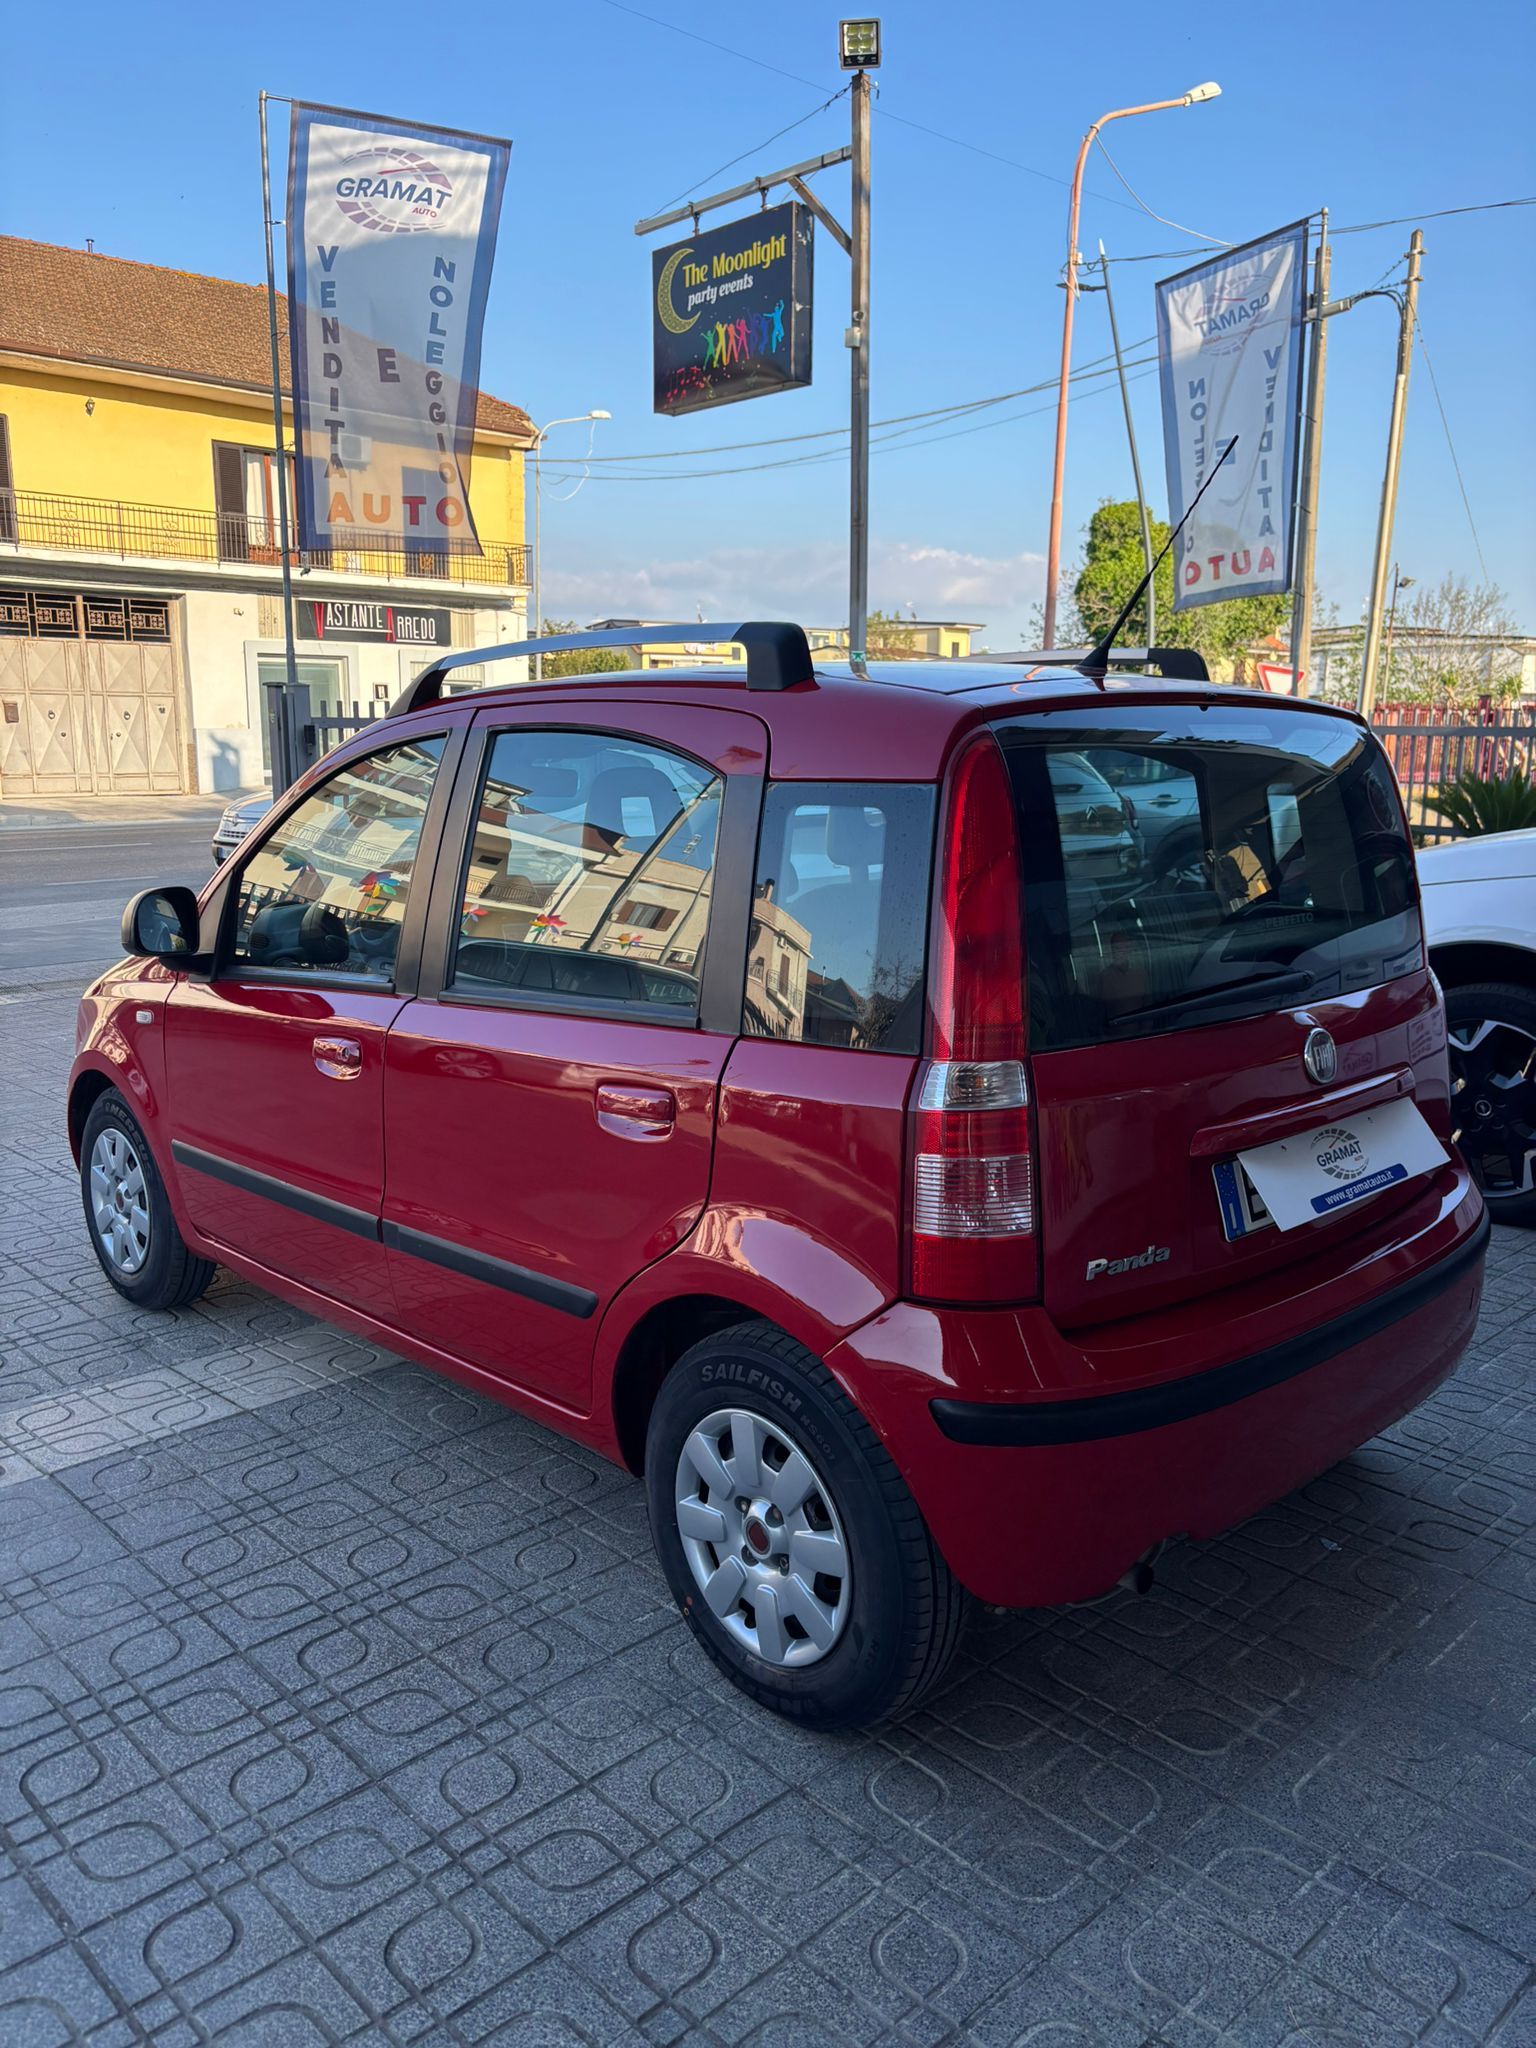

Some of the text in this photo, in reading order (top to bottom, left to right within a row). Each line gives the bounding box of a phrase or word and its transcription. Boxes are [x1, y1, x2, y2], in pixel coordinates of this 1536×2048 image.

[336, 177, 453, 209] GRAMAT
[412, 207, 438, 219] AUTO
[683, 234, 787, 288] The Moonlight
[688, 273, 753, 312] party events
[317, 245, 347, 479] VENDITA
[376, 347, 401, 383] E
[425, 256, 457, 485] NOLEGGIO
[327, 491, 464, 527] AUTO
[312, 600, 436, 642] VASTANTE ARREDO
[1316, 1140, 1362, 1167] GRAMAT
[1325, 1171, 1394, 1205] www.gramatauto.it
[1086, 1245, 1170, 1281] Panda
[701, 1363, 802, 1413] SAILFISH
